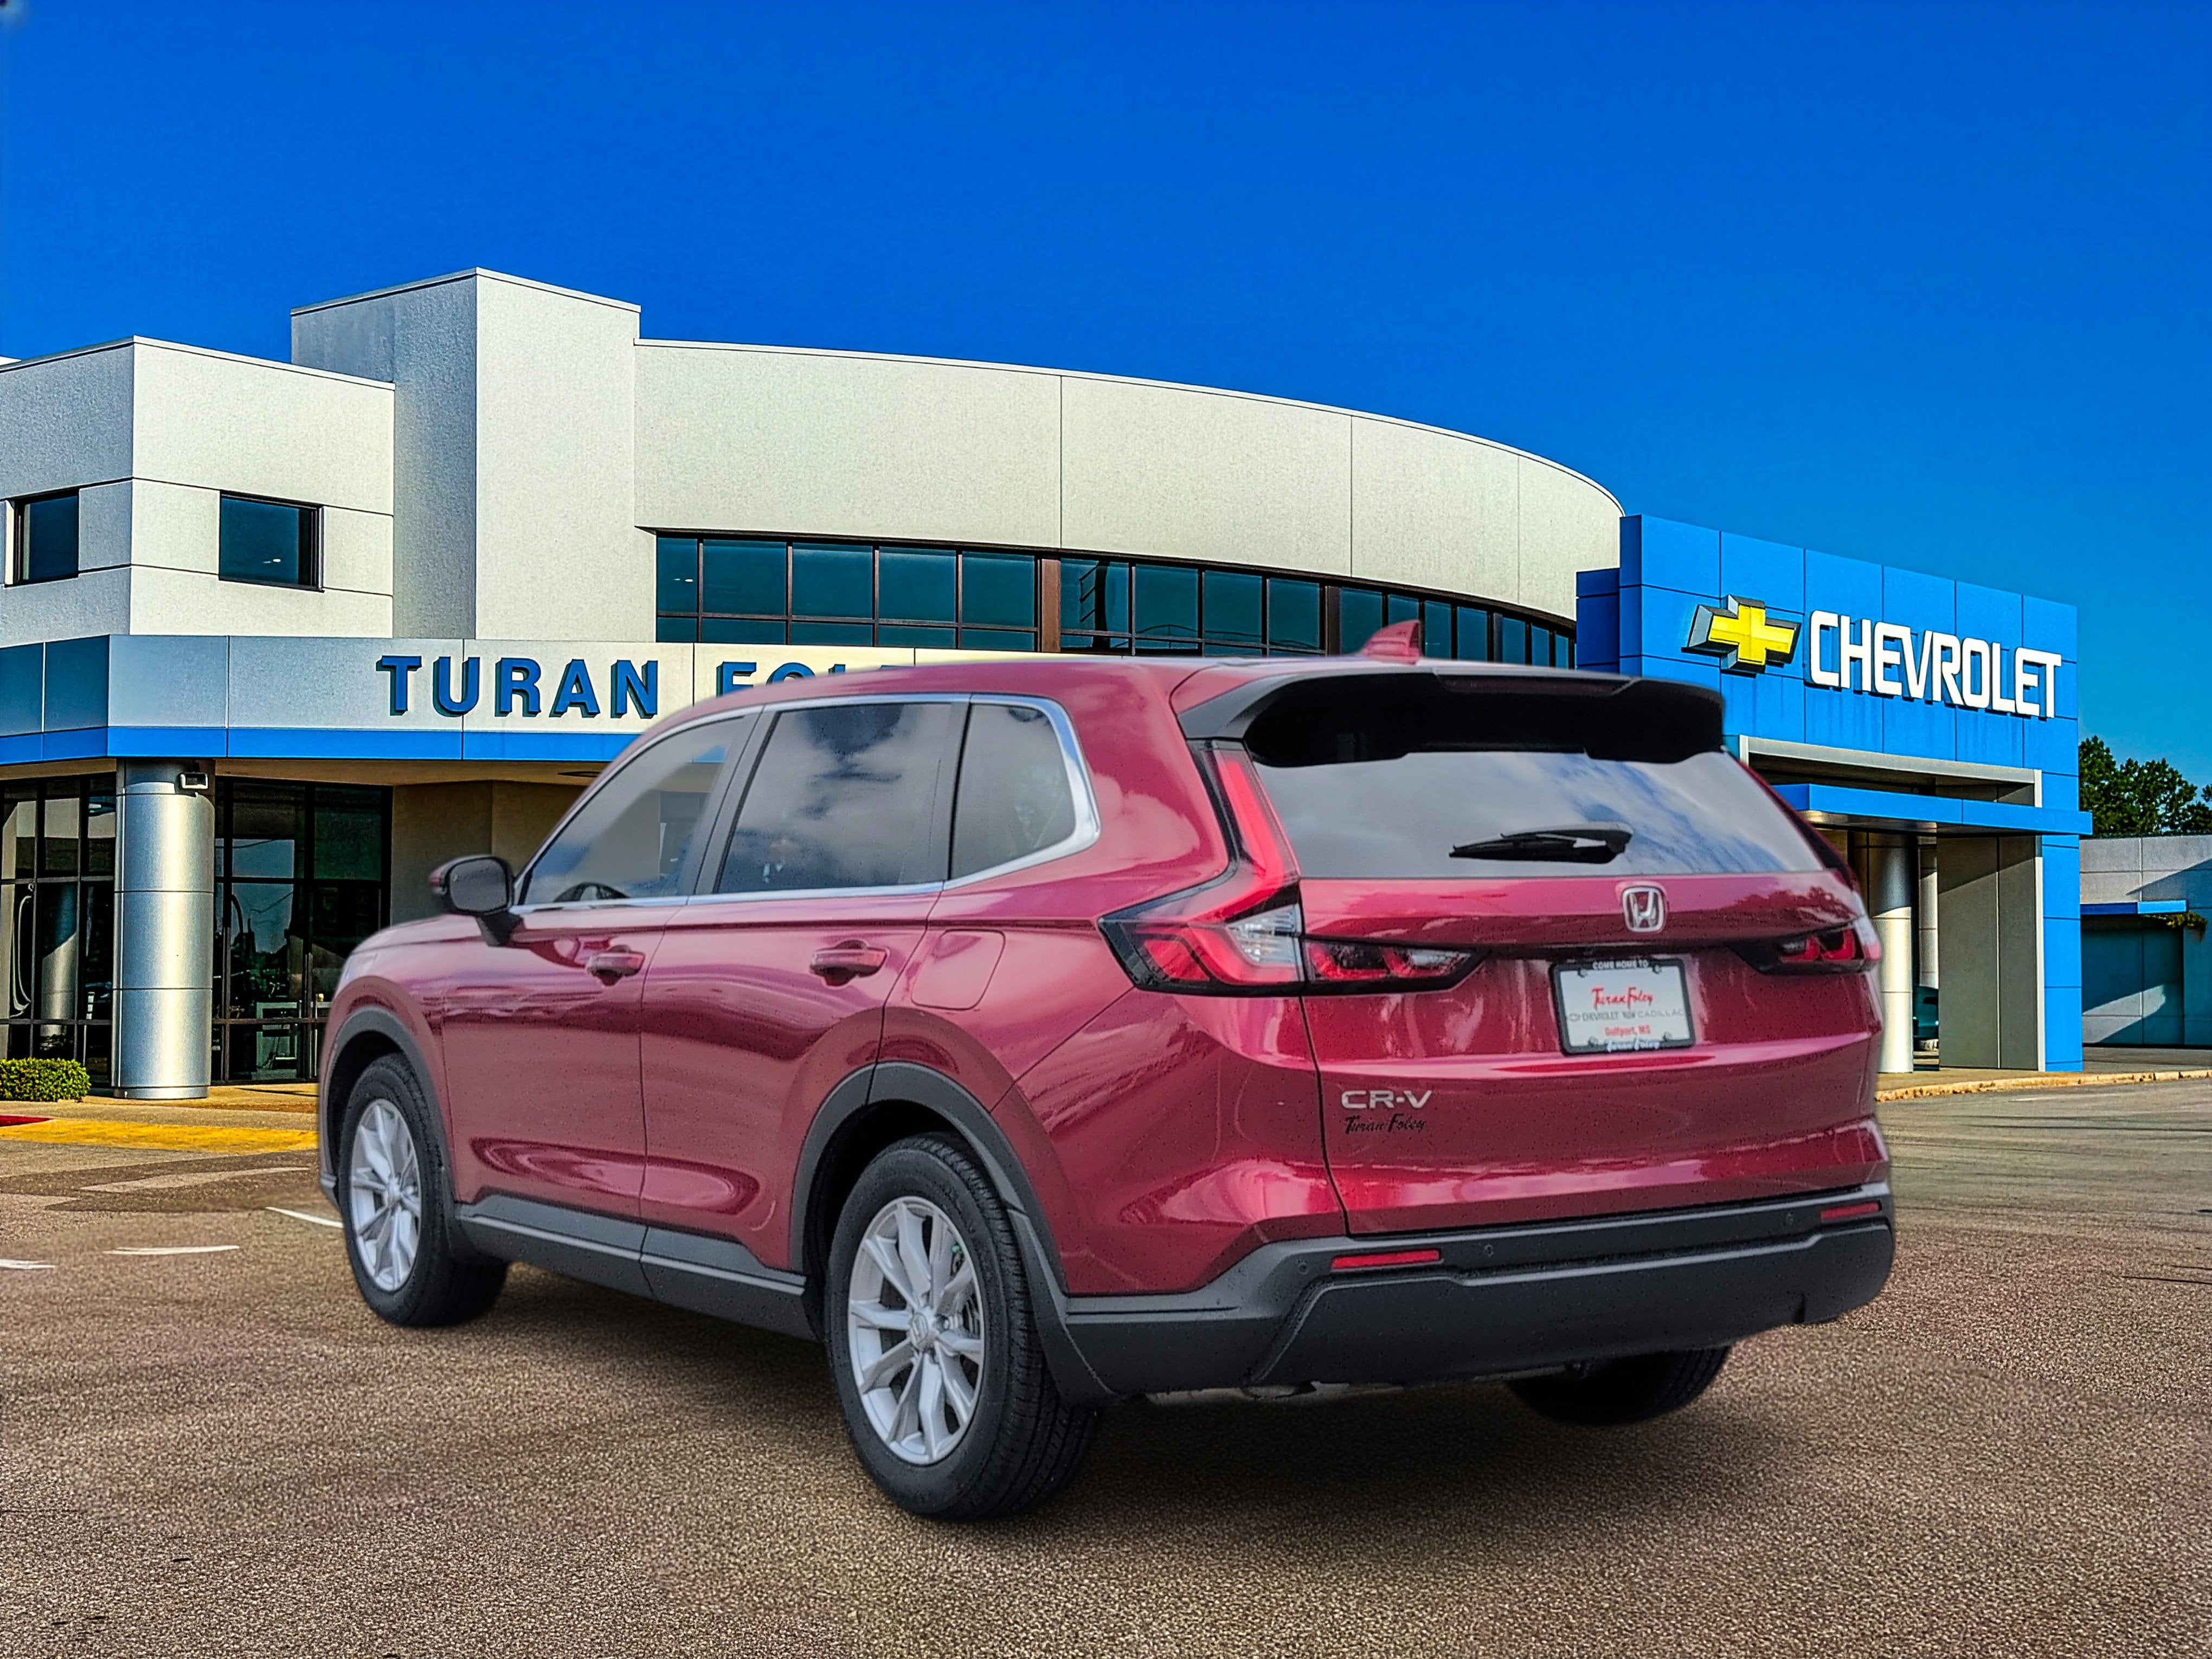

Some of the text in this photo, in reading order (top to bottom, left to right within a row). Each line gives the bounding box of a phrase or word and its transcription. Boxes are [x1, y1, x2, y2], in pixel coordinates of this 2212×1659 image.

[1809, 610, 2062, 719] CHEVROLET
[377, 655, 658, 719] TURAN
[1638, 959, 1649, 968] TO
[1341, 1090, 1432, 1109] CR-V
[1345, 1115, 1385, 1135] Turan
